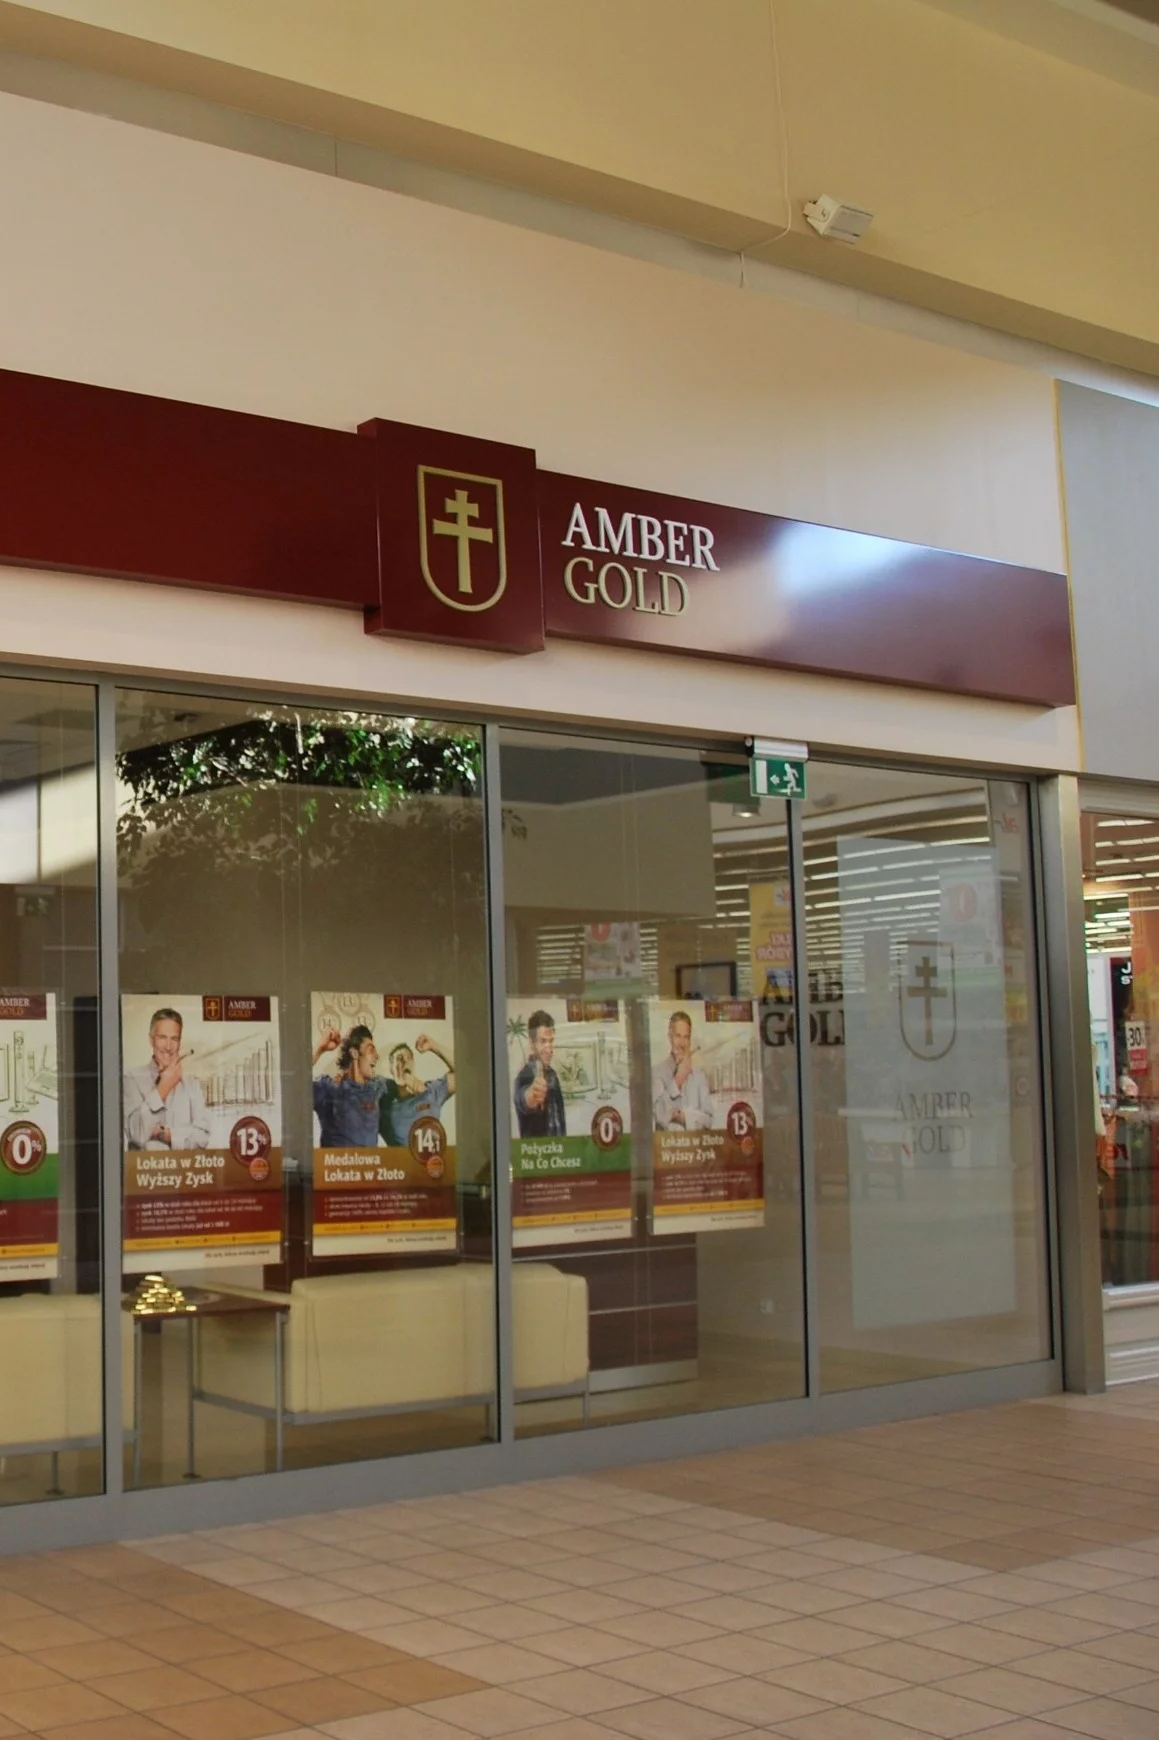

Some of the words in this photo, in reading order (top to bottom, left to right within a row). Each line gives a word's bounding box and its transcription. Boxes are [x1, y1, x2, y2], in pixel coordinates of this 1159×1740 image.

[561, 502, 720, 571] AMBER
[564, 556, 689, 616] GOLD
[228, 1000, 257, 1009] AMBER
[662, 1135, 691, 1147] Lokata
[693, 1137, 701, 1146] w
[702, 1135, 725, 1146] Złoto
[521, 1142, 564, 1157] Pożyczka
[662, 1149, 694, 1164] Wyższy
[696, 1148, 716, 1163] Zysk
[136, 1156, 177, 1170] Lokata
[180, 1158, 191, 1168] w
[194, 1154, 225, 1168] Złoto
[324, 1153, 381, 1166] Medalowa
[522, 1158, 534, 1169] Na
[536, 1157, 549, 1169] Co
[550, 1156, 581, 1169] Chcesz
[136, 1173, 182, 1190] Wyższy
[185, 1171, 214, 1188] Zysk
[324, 1170, 361, 1182] Lokata
[364, 1171, 375, 1181] w
[377, 1168, 406, 1181] Złoto
